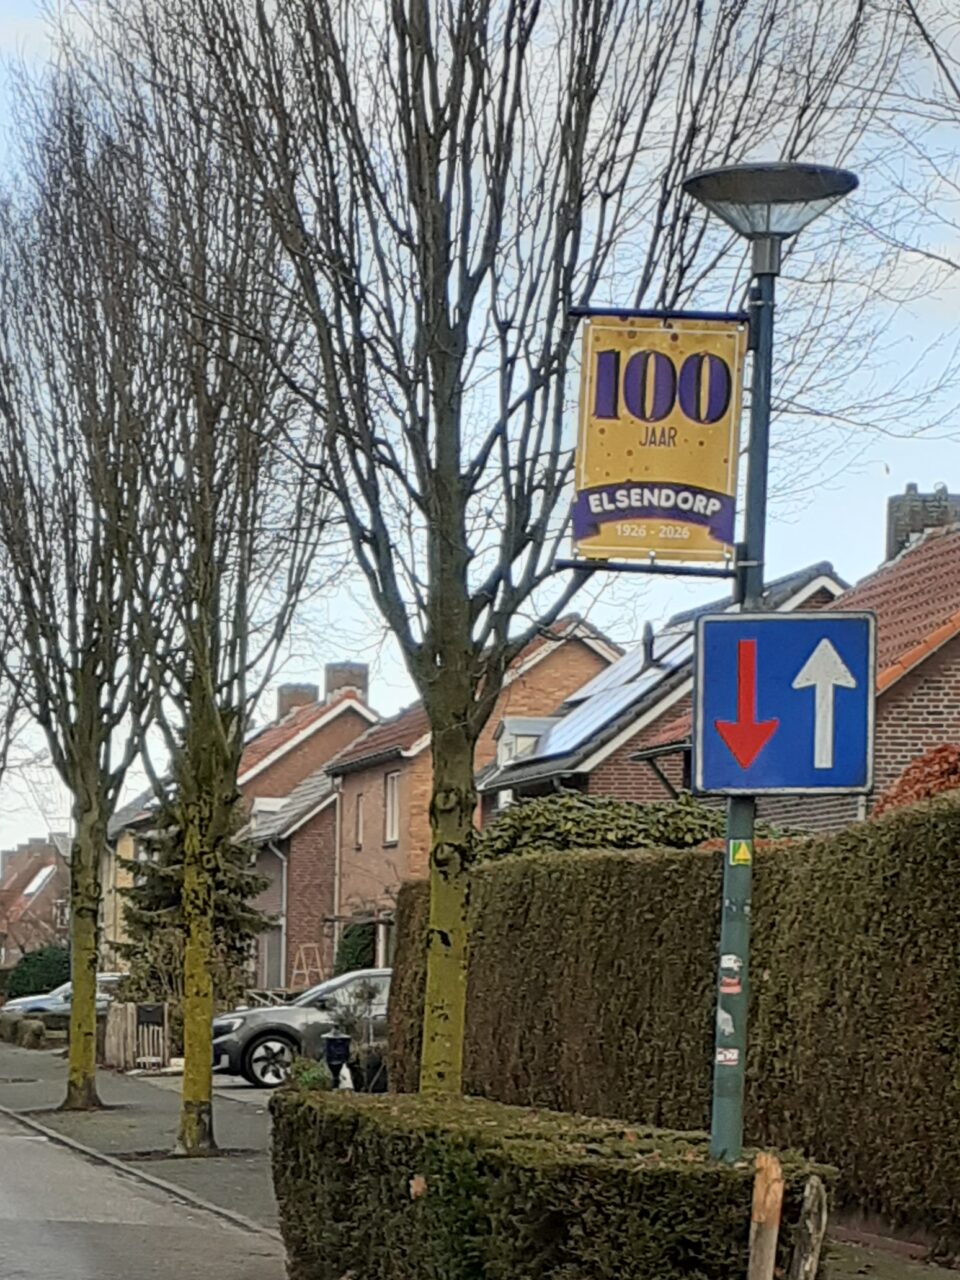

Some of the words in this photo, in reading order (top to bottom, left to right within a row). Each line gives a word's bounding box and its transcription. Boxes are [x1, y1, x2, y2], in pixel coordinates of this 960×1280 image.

[593, 348, 732, 425] 100
[639, 427, 677, 447] JAAR
[588, 487, 721, 517] ELSENDORP
[616, 524, 647, 537] 1926
[659, 525, 690, 539] 2026
